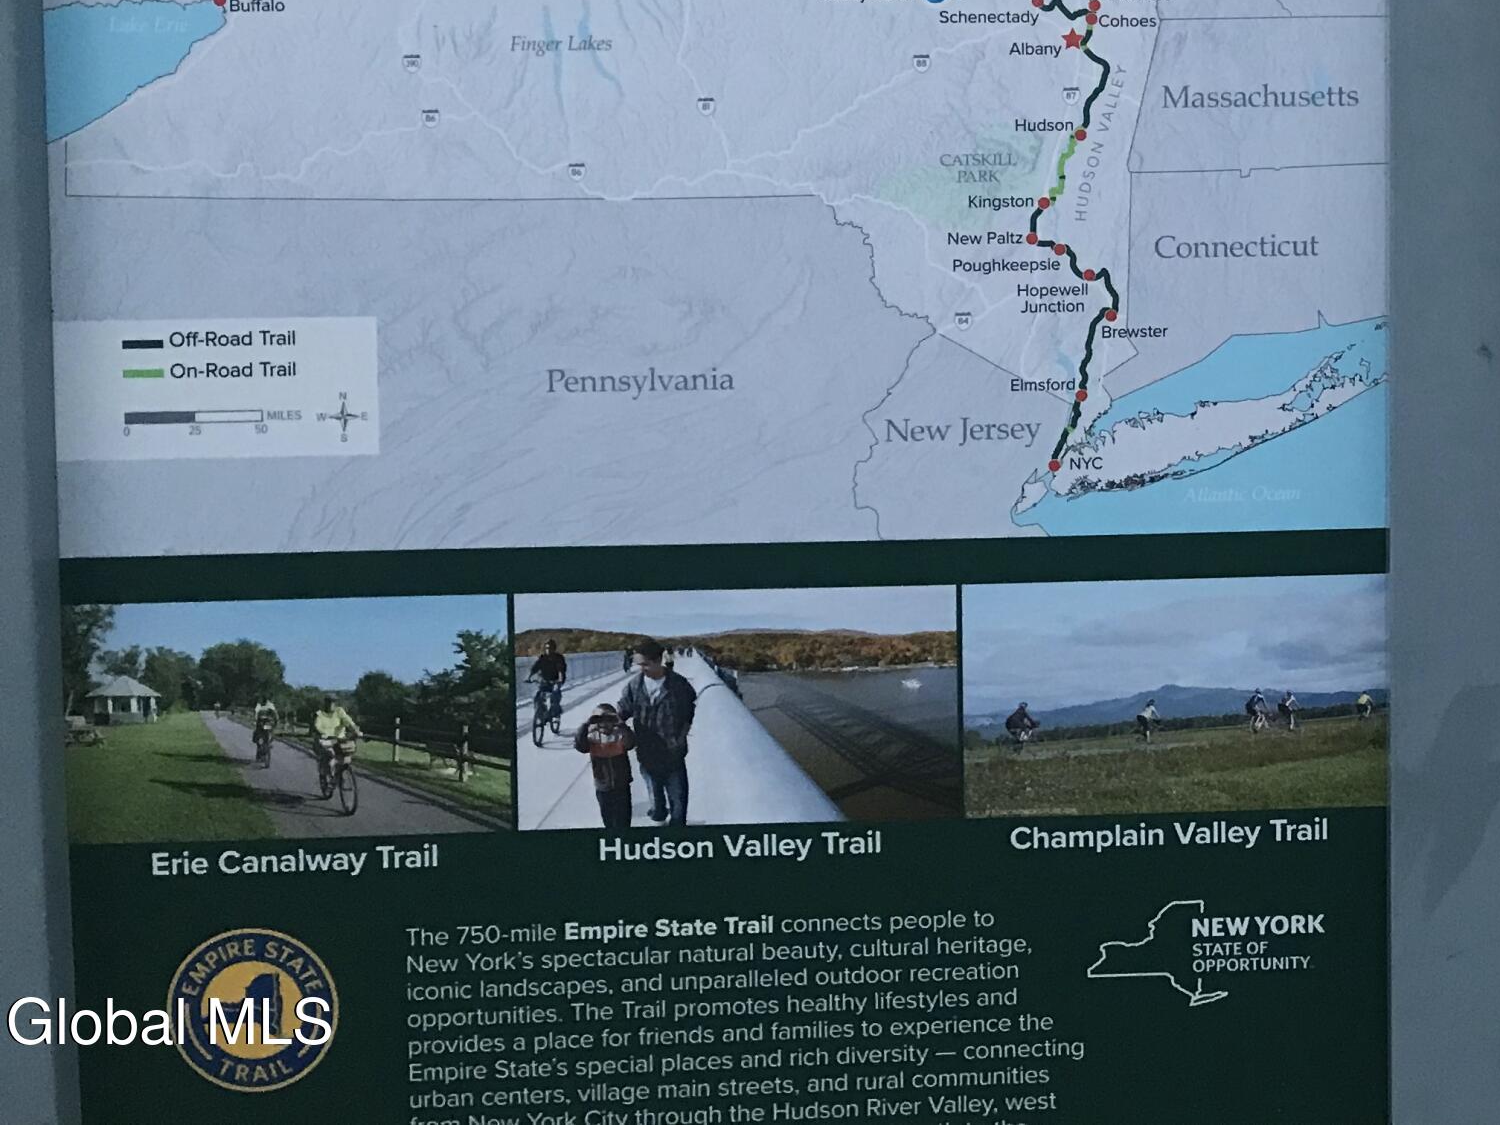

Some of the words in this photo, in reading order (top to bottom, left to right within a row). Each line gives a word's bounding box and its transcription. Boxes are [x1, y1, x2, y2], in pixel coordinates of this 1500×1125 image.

[229, 0, 285, 13] Buffalo
[939, 10, 1039, 26] Schenectady
[1099, 14, 1157, 28] Cohoes
[1009, 42, 1062, 58] Albany
[1161, 84, 1359, 109] Massachusetts
[1014, 118, 1074, 133] Hudson
[968, 195, 1034, 211] Kingston
[947, 232, 984, 246] New
[987, 232, 1023, 245] Paltz
[1154, 234, 1319, 259] Connecticut
[953, 258, 1060, 275] Poughkeepsie
[1017, 283, 1089, 299] Hopewell
[1020, 300, 1085, 314] Junction
[169, 331, 252, 348] Off-Road
[259, 330, 296, 346] Trail
[1101, 324, 1168, 339] Brewster
[169, 362, 252, 379] On-Road
[259, 361, 296, 377] Trail
[547, 367, 735, 400] Pennsylvania
[1010, 377, 1076, 392] Elmsford
[266, 410, 302, 421] MILES
[885, 418, 950, 442] New
[959, 418, 1042, 446] Jersey
[1069, 456, 1103, 471] NYC
[1010, 823, 1164, 852] Champlain
[1174, 820, 1261, 849] Valley
[1269, 817, 1328, 842] Trail
[599, 836, 714, 862] Hudson
[722, 833, 812, 862] Valley
[821, 830, 881, 857] Trail
[151, 851, 209, 876] Erie
[218, 848, 368, 876] Canalway
[375, 843, 438, 870] Trail
[406, 927, 449, 947] The
[456, 923, 557, 945] 750-mile
[564, 919, 648, 943] Empire
[655, 918, 717, 938] State
[723, 915, 774, 934] Trail
[781, 914, 882, 933] connects
[889, 910, 966, 934] people
[974, 909, 994, 928] to
[1191, 916, 1249, 938] NEW
[1253, 914, 1325, 936] YORK
[406, 955, 458, 974] New
[541, 947, 671, 972] spectacular
[679, 943, 754, 963] natural
[762, 940, 843, 962] beauty,
[850, 938, 930, 957] cultural
[937, 936, 1032, 957] heritage,
[1192, 942, 1242, 957] STATE
[1246, 941, 1269, 955] OF
[182, 938, 256, 997] EMPIRE
[264, 941, 325, 993] STATE
[220, 1058, 294, 1083] TRAIL
